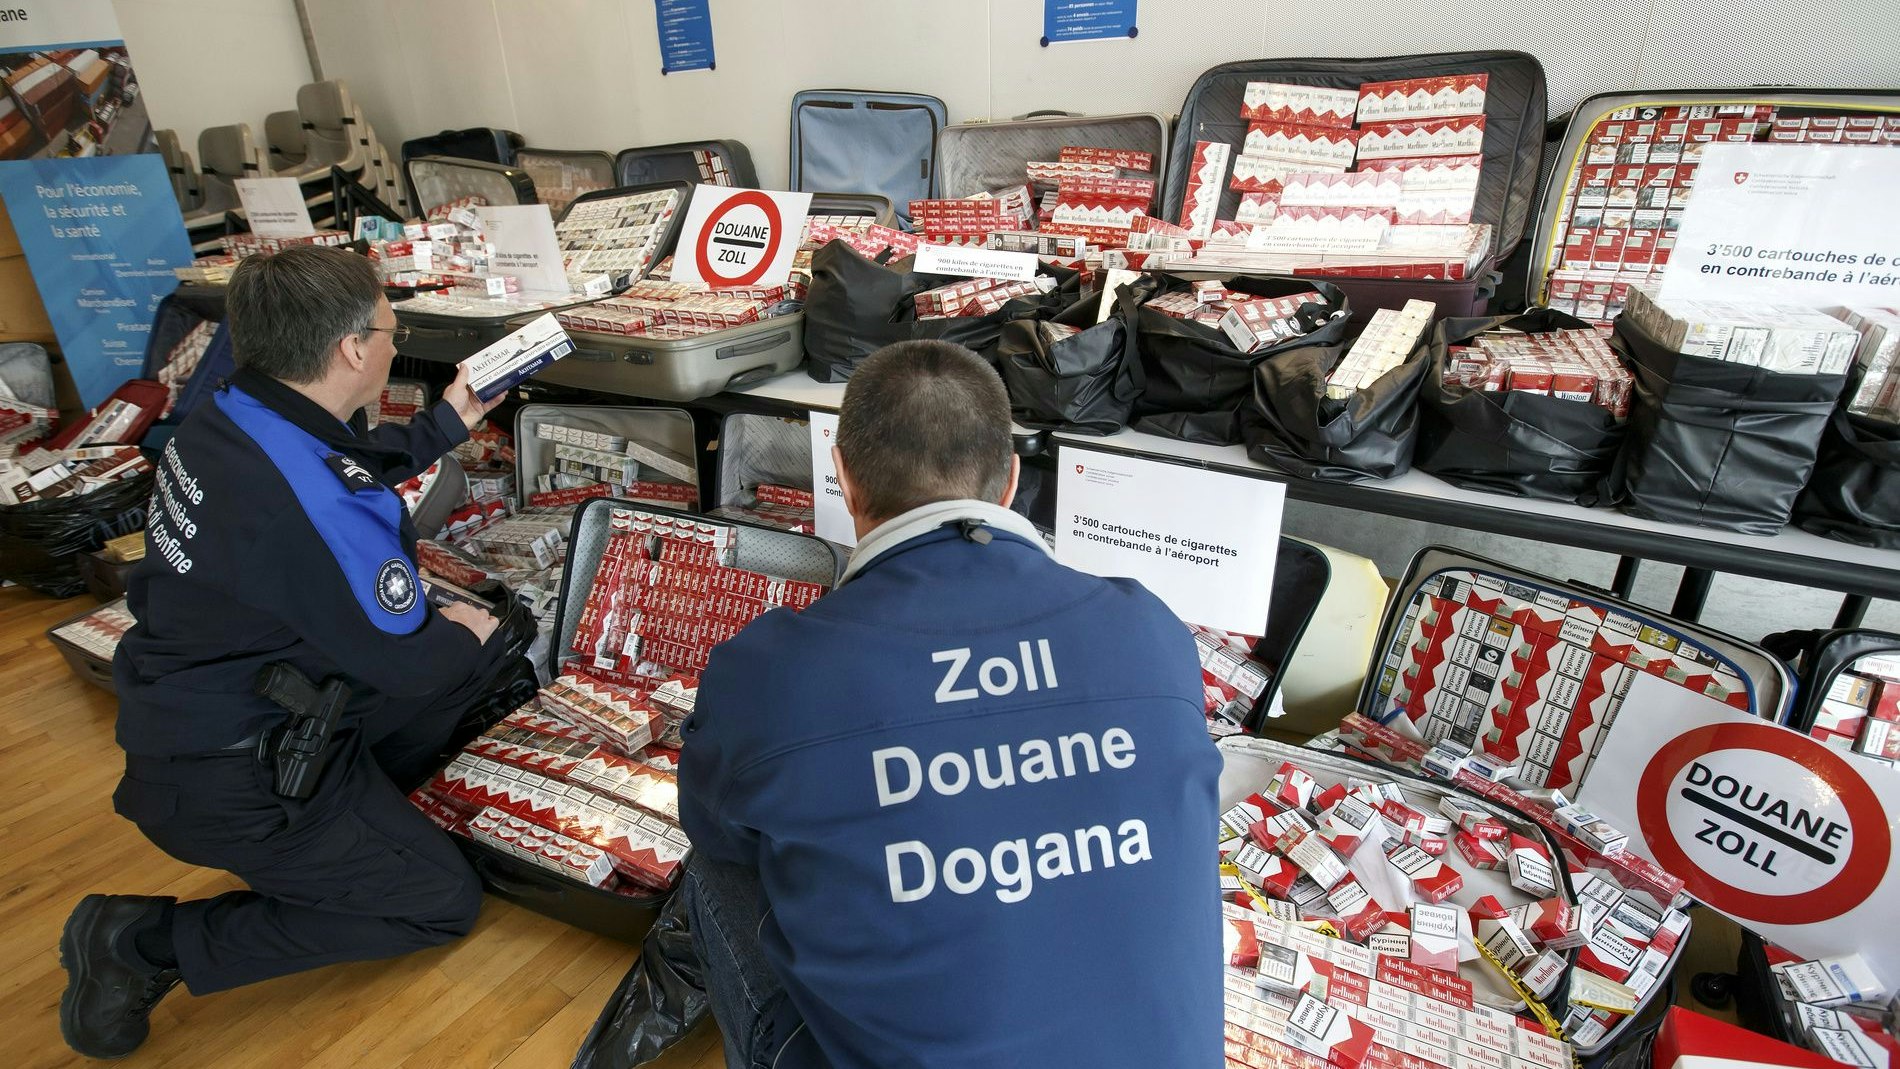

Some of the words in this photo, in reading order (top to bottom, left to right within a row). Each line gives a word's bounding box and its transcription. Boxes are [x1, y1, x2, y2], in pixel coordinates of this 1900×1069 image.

[0, 9, 28, 21] ane
[36, 185, 65, 198] Pour
[66, 182, 142, 197] l'économie,
[44, 206, 57, 218] la
[59, 204, 110, 218] sécurité
[112, 205, 127, 216] et
[52, 226, 65, 238] la
[66, 224, 101, 237] santé
[715, 222, 769, 240] DOUANE
[718, 249, 746, 264] ZOLL
[952, 258, 968, 266] kilos
[980, 262, 1014, 270] cigarettes
[1707, 244, 1753, 258] 3'500
[1757, 246, 1858, 264] cartouches
[1864, 254, 1886, 267] de
[936, 266, 978, 274] contrebande
[986, 268, 1020, 278] l'aéroport
[1700, 264, 1722, 275] en
[1726, 264, 1838, 283] contrebande
[1843, 270, 1854, 284] à
[1802, 332, 1826, 367] Marlboro
[472, 348, 510, 374] AKHTAMAR
[518, 358, 544, 376] AKHTAMAR
[1561, 392, 1587, 401] Winston
[164, 436, 204, 505] Grenzwache
[825, 475, 838, 484] 900
[156, 466, 197, 540] arde-frontière
[1074, 514, 1100, 529] 3'500
[1102, 522, 1161, 542] cartouches
[1164, 534, 1178, 546] de
[1180, 538, 1238, 558] cigarettes
[152, 524, 192, 574] confine
[1072, 528, 1085, 538] en
[1087, 530, 1152, 554] contrebande
[1154, 545, 1162, 555] à
[1165, 546, 1220, 568] l'aéroport
[1539, 594, 1568, 609] Куріння
[1465, 612, 1478, 636] Куріння
[1564, 620, 1594, 636] Куріння
[1606, 617, 1638, 634] Куріння
[1456, 638, 1468, 663] Куріння
[1563, 647, 1578, 675] Куріння
[931, 638, 1058, 704] Zoll
[1446, 666, 1458, 690] Куріння
[1552, 677, 1566, 704] Куріння
[1437, 692, 1448, 716] Куріння
[1542, 706, 1556, 732] Куріння
[1532, 735, 1545, 760] Куріння
[872, 727, 1136, 808] Douane
[1686, 762, 1848, 849] DOUANE
[1232, 810, 1251, 826] Курін
[1479, 826, 1503, 840] Marlboro
[1457, 838, 1474, 863] Marlboro
[1694, 818, 1778, 876] ZOLL
[885, 818, 1152, 904] Dogana
[1520, 860, 1552, 878] Куріння
[1436, 883, 1460, 901] Marlboro
[1522, 882, 1546, 896] Marlboro
[1358, 918, 1386, 938] Marlboro
[1416, 920, 1456, 934] Куріння
[1370, 936, 1408, 946] Куріння
[1596, 936, 1632, 960] Куріння
[1342, 944, 1370, 960] Marlboro
[1339, 957, 1368, 974] Marlboro
[1384, 958, 1419, 976] Marlboro
[1534, 962, 1558, 986] Marlboro
[1384, 972, 1419, 991] Marlboro
[1432, 973, 1467, 992] Marlboro
[1378, 982, 1408, 1001] Marlboro
[1432, 987, 1468, 1007] Marlboro
[1377, 1000, 1406, 1016] Marlboro
[1426, 1002, 1456, 1018] Marlboro
[1310, 1003, 1330, 1034] Куріння
[1366, 1010, 1398, 1030] Marlboro
[1425, 1016, 1456, 1033] Marlboro
[1475, 1018, 1508, 1035] Marlboro
[1375, 1031, 1395, 1046] rlboro
[1416, 1028, 1448, 1046] Marlboro
[1476, 1033, 1508, 1051] Marlboro
[1527, 1034, 1562, 1053] Marlboro
[1414, 1045, 1448, 1063] Marlboro
[1468, 1046, 1500, 1064] Marlboro
[1528, 1050, 1564, 1068] Marlboro
